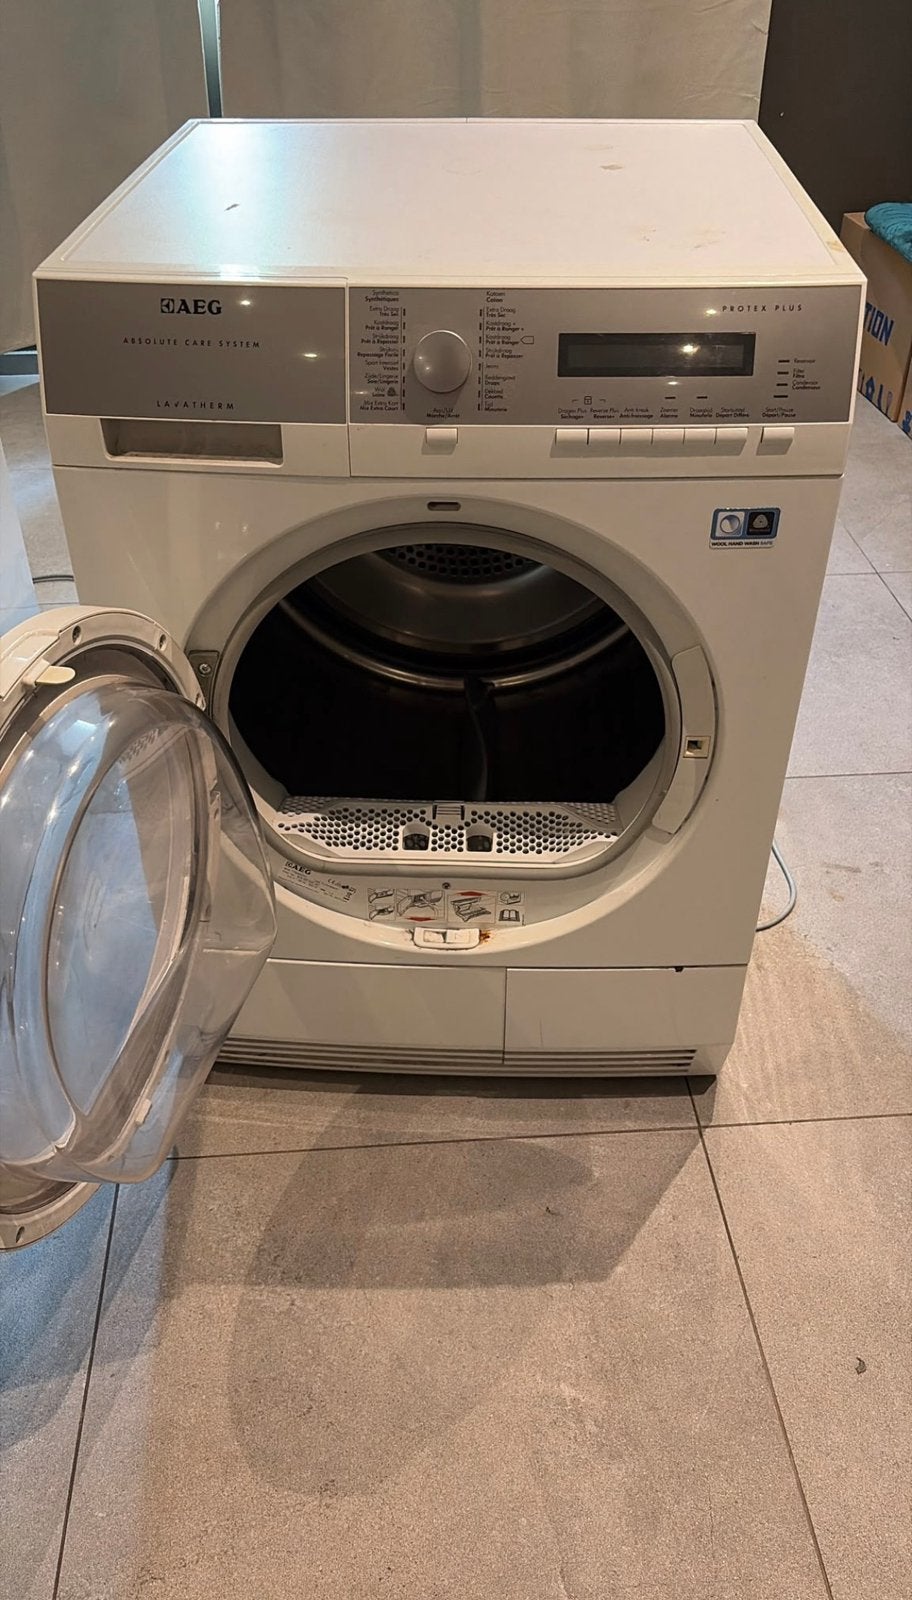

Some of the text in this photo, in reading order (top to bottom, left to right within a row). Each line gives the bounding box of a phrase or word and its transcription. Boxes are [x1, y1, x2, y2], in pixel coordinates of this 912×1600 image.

[177, 299, 222, 315] AEG
[775, 304, 802, 312] PLUS
[123, 337, 260, 348] ABSOLUTE CARE SYSTEM
[156, 401, 234, 410] LAVATHERM
